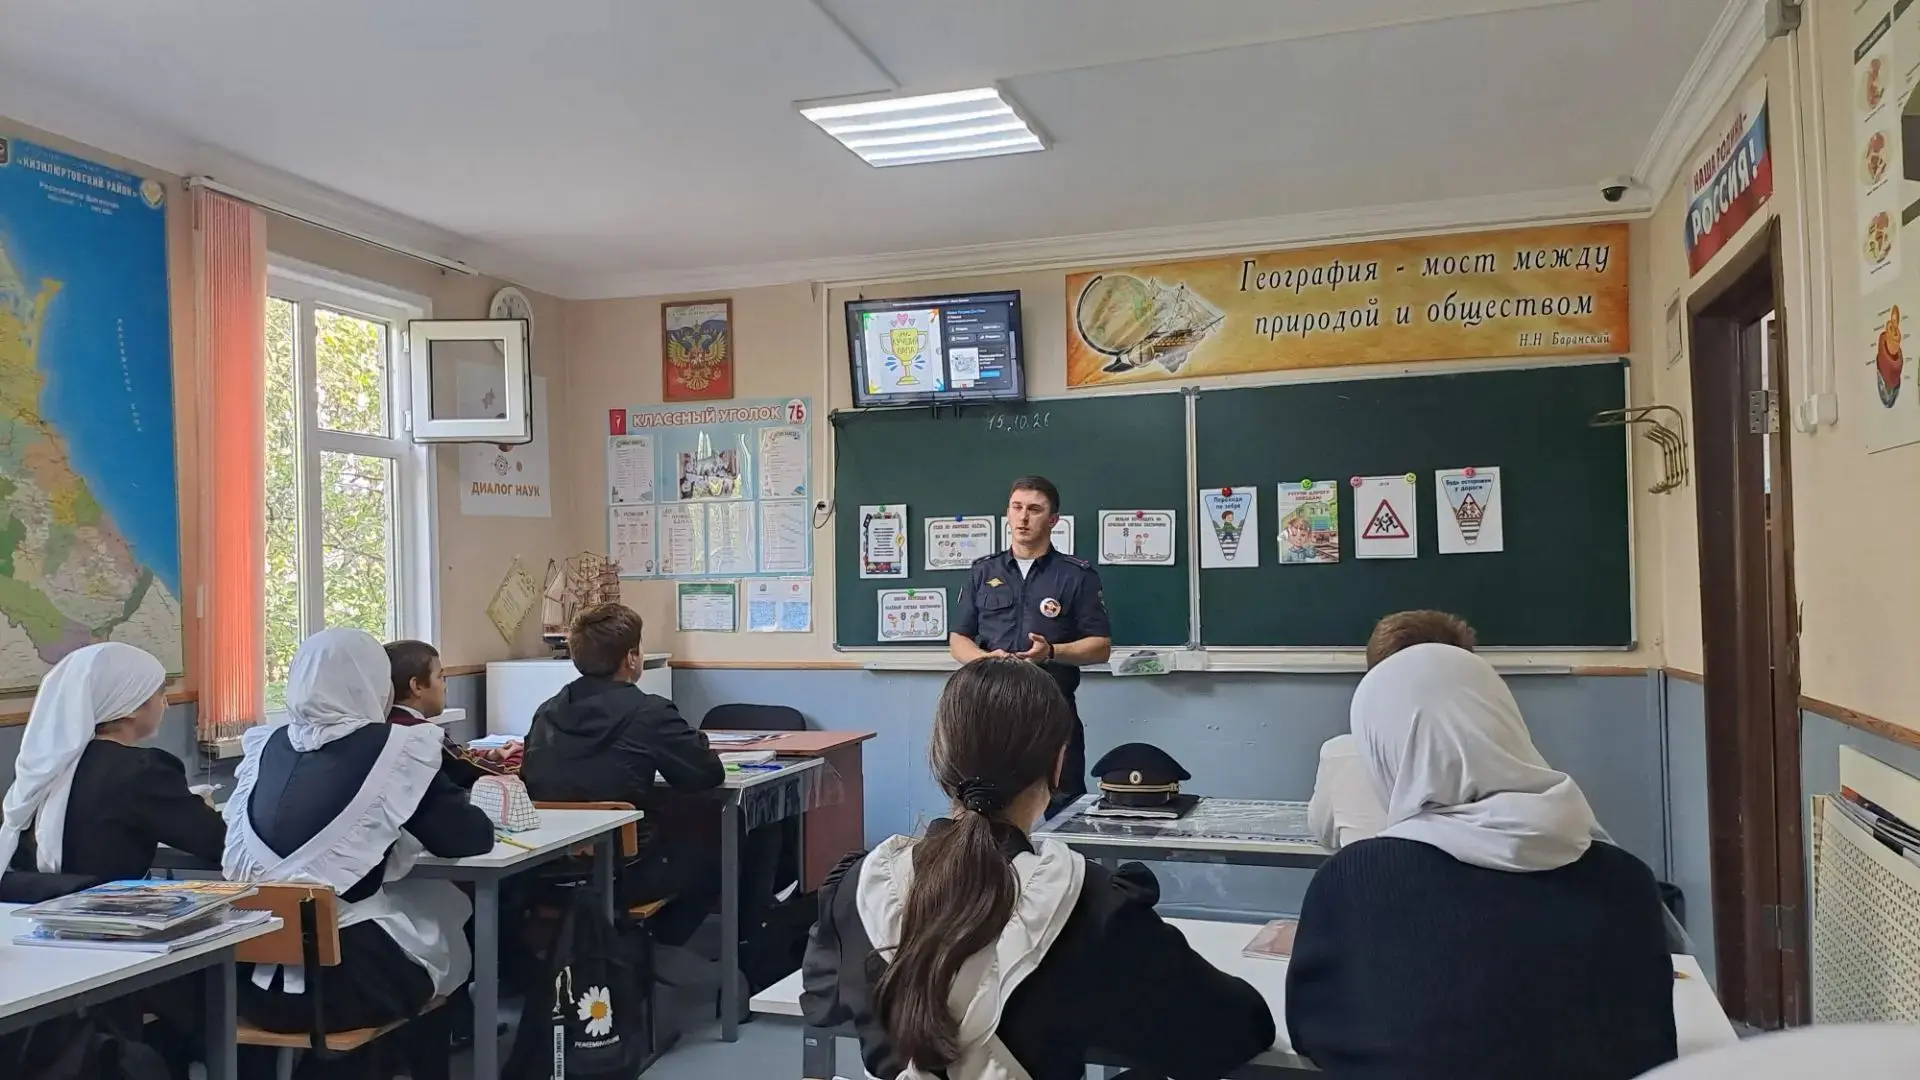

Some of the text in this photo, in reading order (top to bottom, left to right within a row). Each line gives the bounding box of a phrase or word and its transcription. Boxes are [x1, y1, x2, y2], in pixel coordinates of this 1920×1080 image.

[1692, 138, 1758, 246] РОССИЯ!
[1239, 260, 1378, 294] География
[1422, 253, 1495, 276] мост
[1513, 245, 1610, 273] между
[1256, 289, 1593, 341] природой и обществом
[1552, 331, 1610, 347] Баранский
[632, 405, 782, 429] КЛАССНЫЙ УГОЛОК
[471, 481, 540, 498] ДИАЛОГ НАУК
